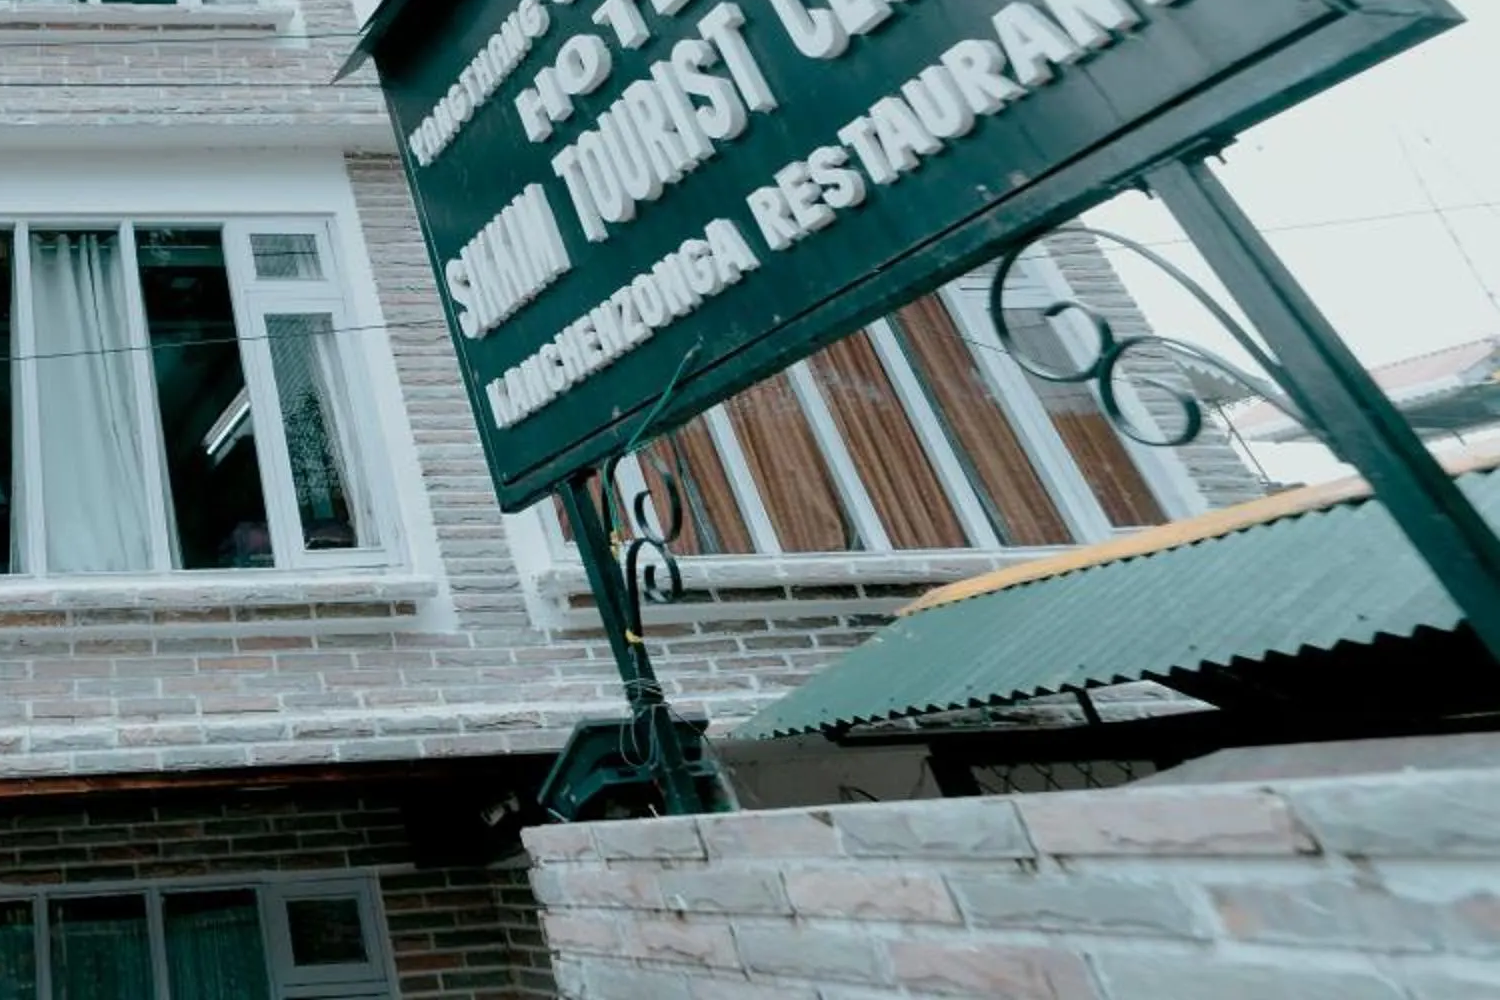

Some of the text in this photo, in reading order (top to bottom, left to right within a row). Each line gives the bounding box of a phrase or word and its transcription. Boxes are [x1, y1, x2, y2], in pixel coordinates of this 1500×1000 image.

[445, 183, 571, 339] SIKKIM
[551, 2, 778, 242] TOURIST
[486, 218, 761, 430] KANCHENZONGA
